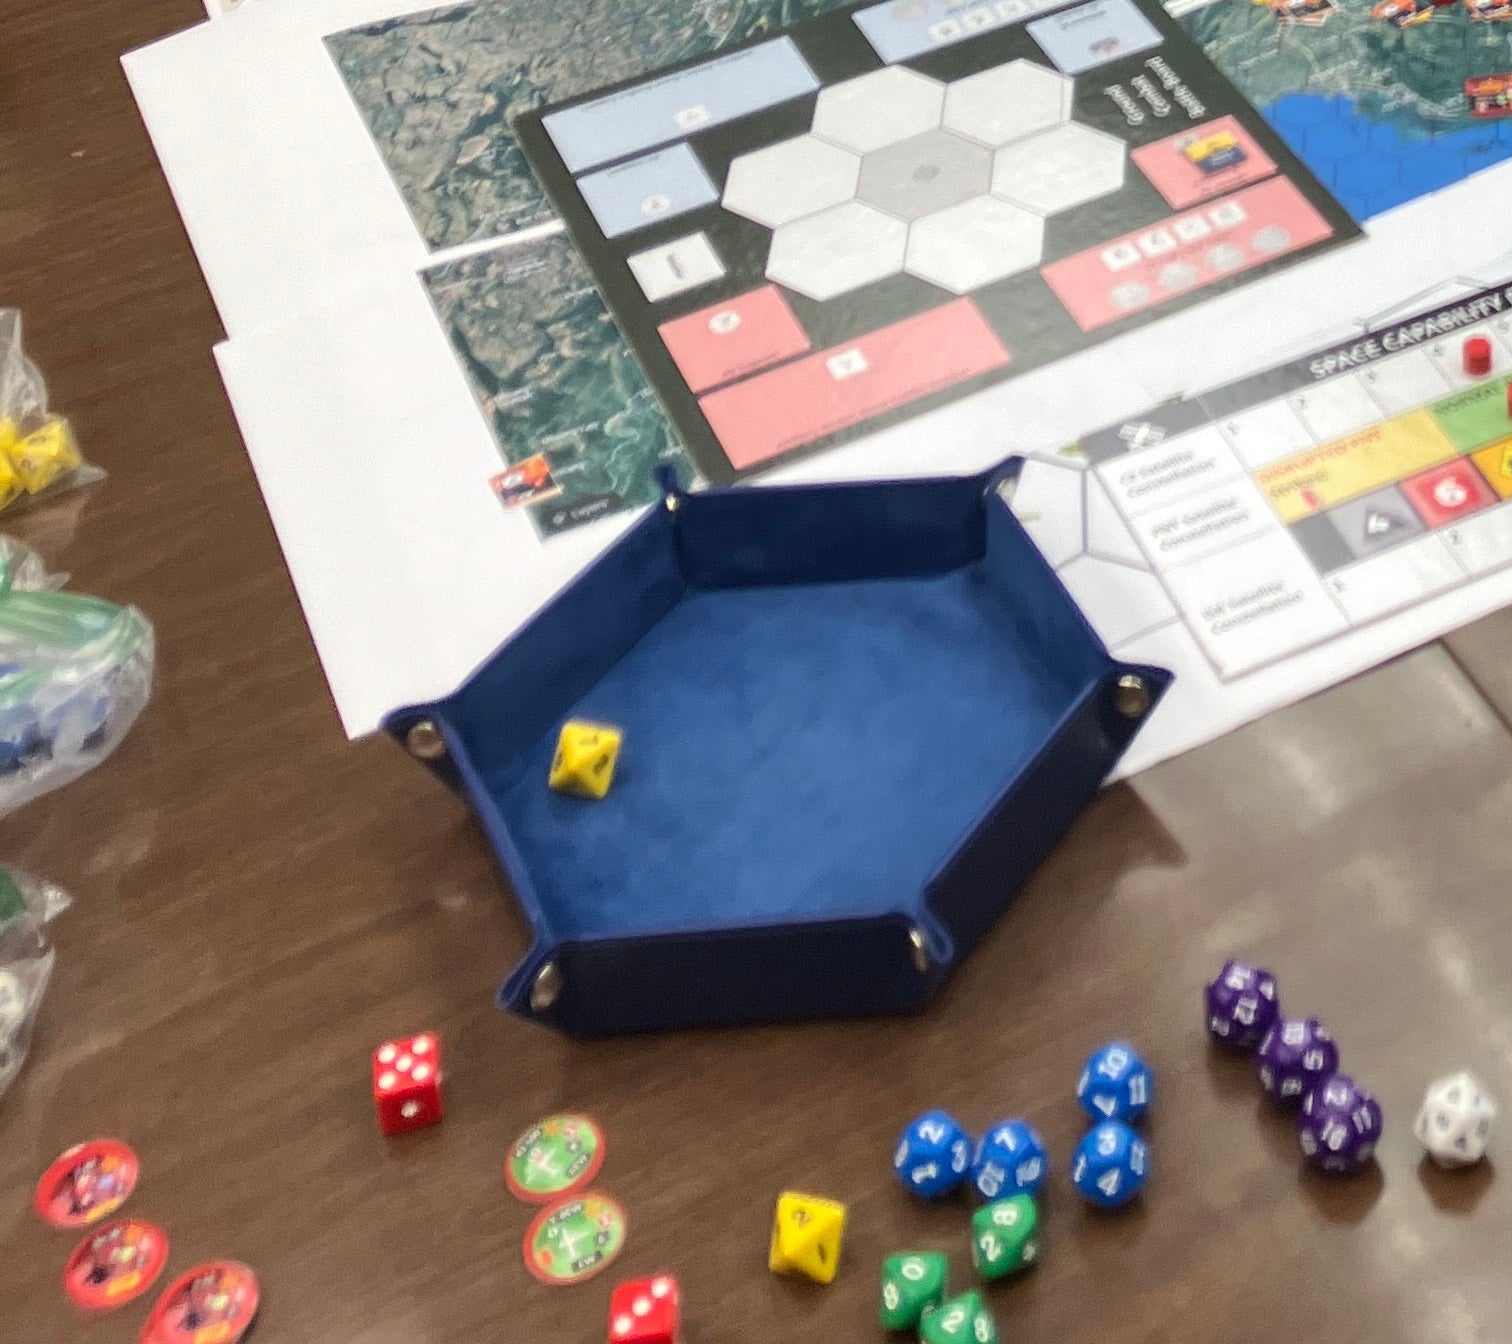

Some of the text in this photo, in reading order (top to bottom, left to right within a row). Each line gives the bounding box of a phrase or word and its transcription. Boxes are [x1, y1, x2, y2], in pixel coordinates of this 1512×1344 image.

[1310, 340, 1381, 381] SPACE
[1381, 291, 1503, 353] CAPABILITY
[1434, 476, 1467, 508] 6
